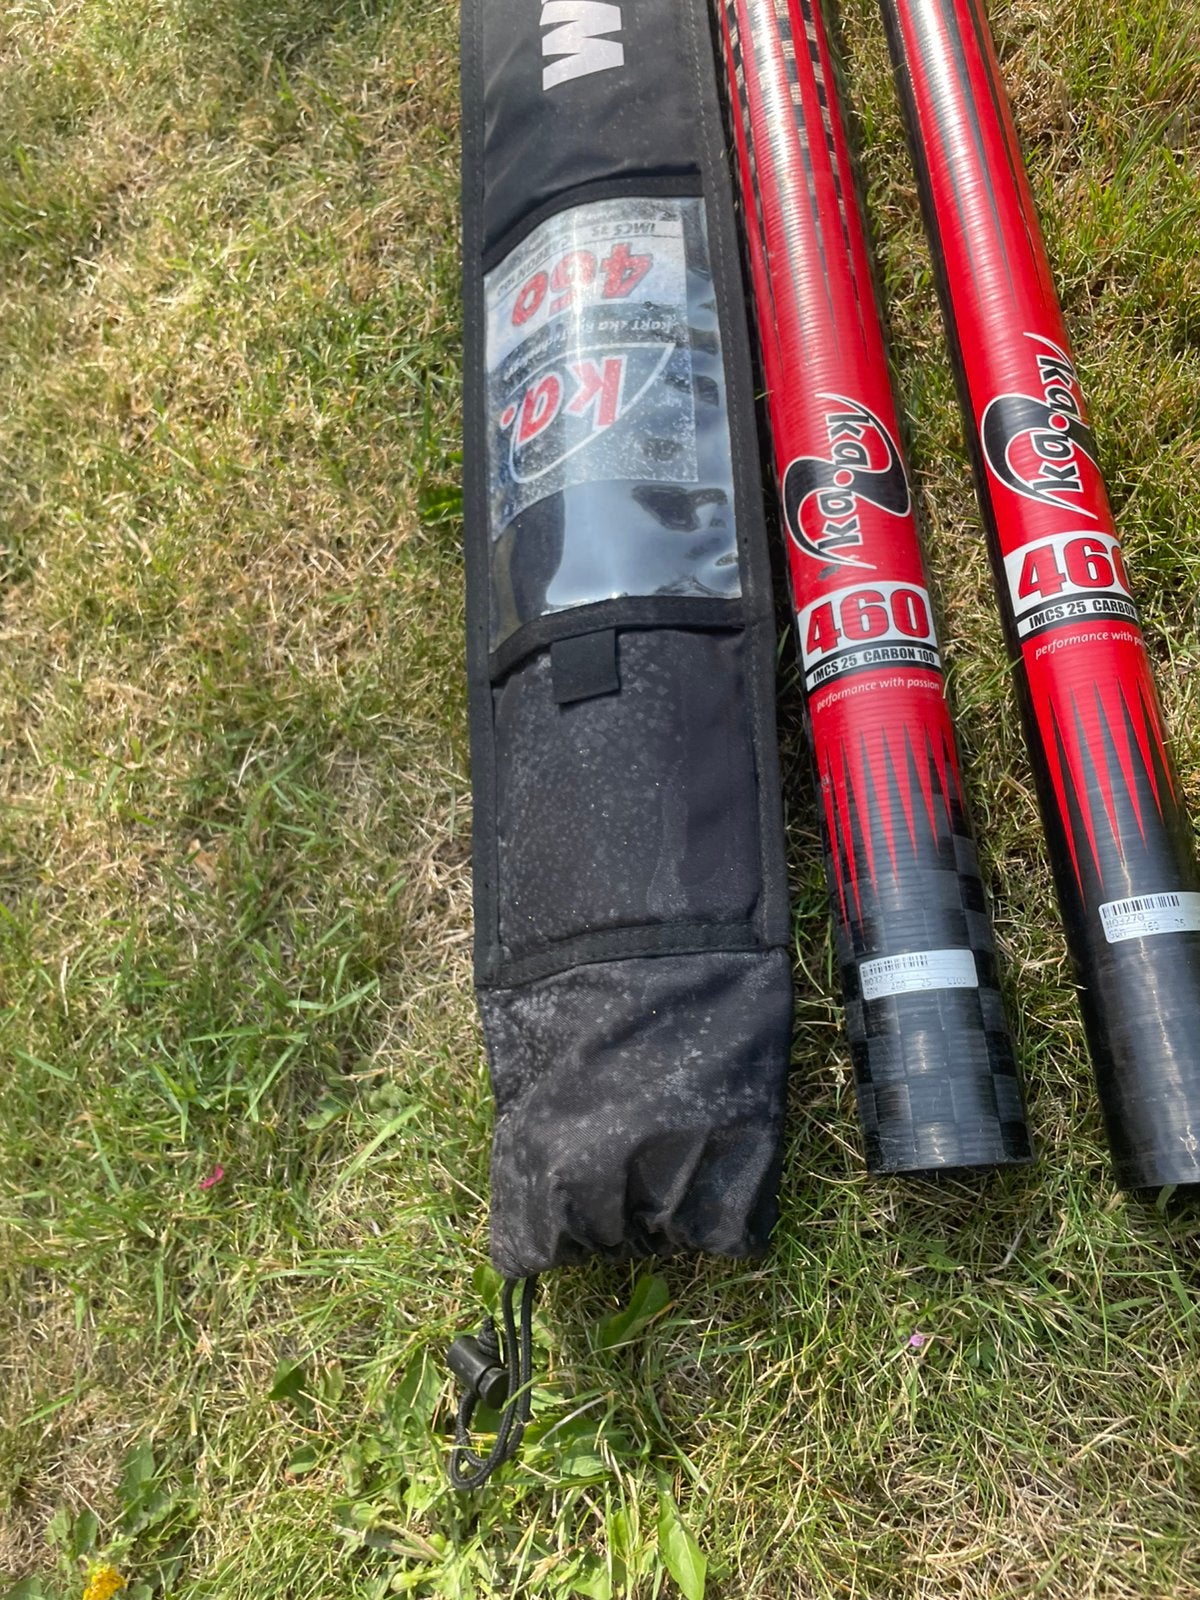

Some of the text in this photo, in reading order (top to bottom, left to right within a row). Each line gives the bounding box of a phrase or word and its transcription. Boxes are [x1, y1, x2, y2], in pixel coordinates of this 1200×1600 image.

[511, 241, 653, 328] 460
[807, 588, 930, 656] 460
[1028, 605, 1065, 629] IMCS
[1067, 601, 1087, 615] 25
[1035, 631, 1109, 659] performance
[1111, 630, 1133, 642] with
[813, 647, 936, 684] IMCS 25 CARBON 100
[816, 677, 940, 712] performance with passion
